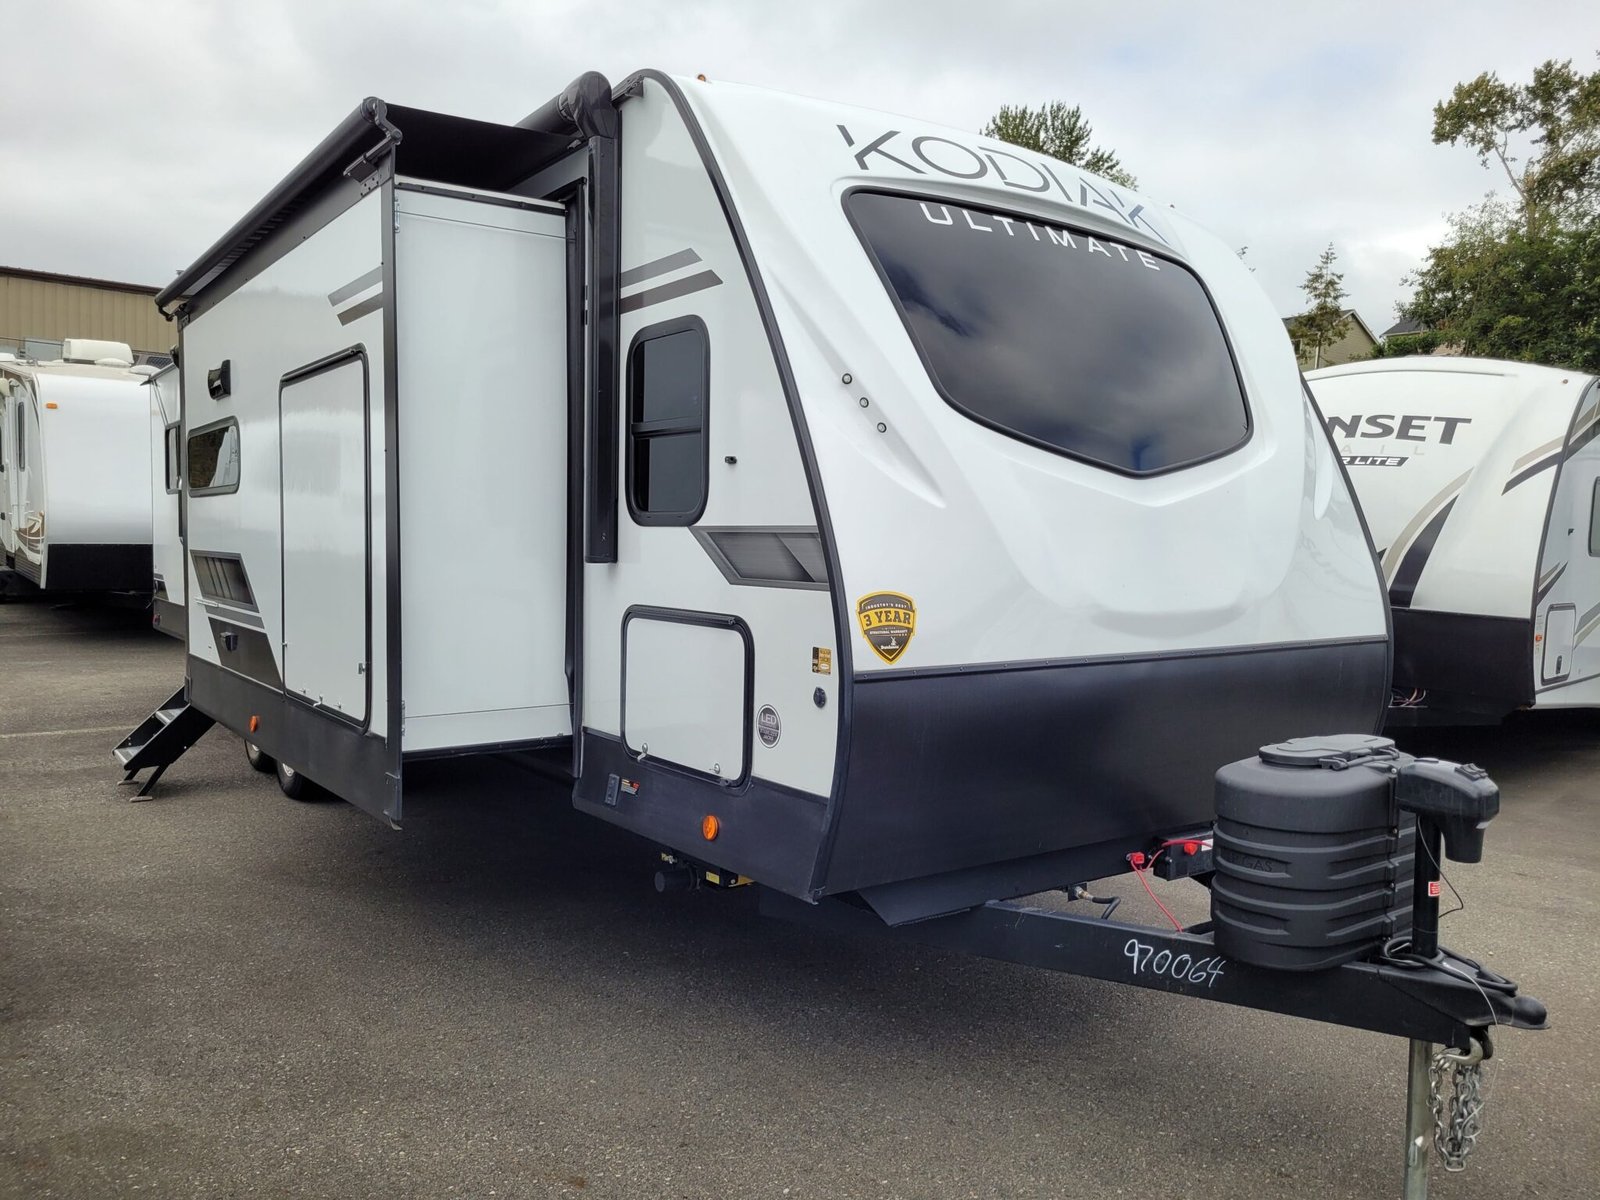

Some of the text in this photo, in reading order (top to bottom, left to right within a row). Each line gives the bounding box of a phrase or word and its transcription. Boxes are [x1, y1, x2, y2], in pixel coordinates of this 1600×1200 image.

[836, 124, 1170, 245] KODIAK
[919, 202, 1161, 271] ULTIMATE
[1354, 456, 1402, 466] LITE
[863, 610, 911, 627] 3 YEAR
[761, 712, 777, 725] LED
[1124, 938, 1227, 988] 970064
